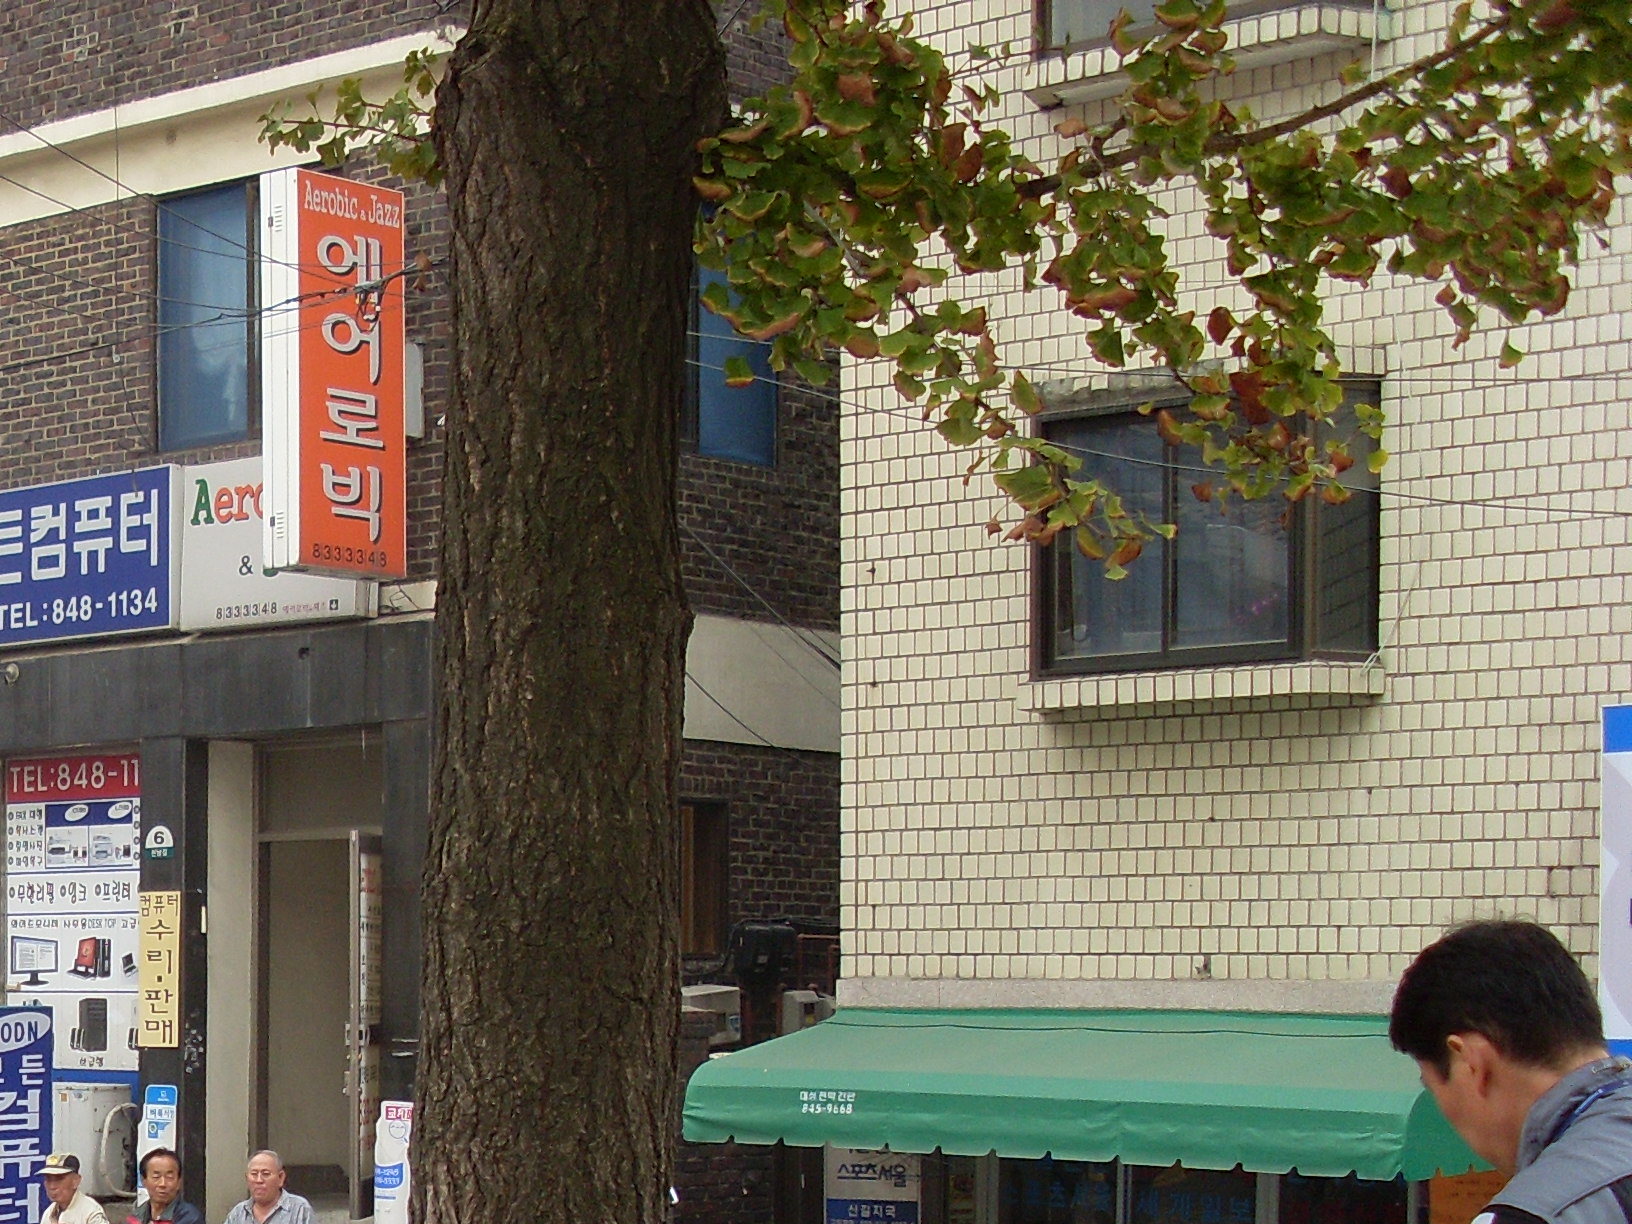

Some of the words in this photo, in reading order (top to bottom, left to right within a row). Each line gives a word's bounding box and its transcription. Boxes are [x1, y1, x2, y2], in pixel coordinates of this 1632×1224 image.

[304, 180, 358, 219] Aerobic
[360, 209, 366, 220] &
[369, 194, 400, 228] Jazz
[317, 234, 384, 543] 에어로빅
[239, 555, 253, 576] &
[313, 543, 387, 567] 8333348
[216, 602, 277, 620] 8333348
[153, 830, 165, 845] 6
[140, 895, 178, 917] 컴퓨터
[837, 1163, 907, 1188] 스포츠서울
